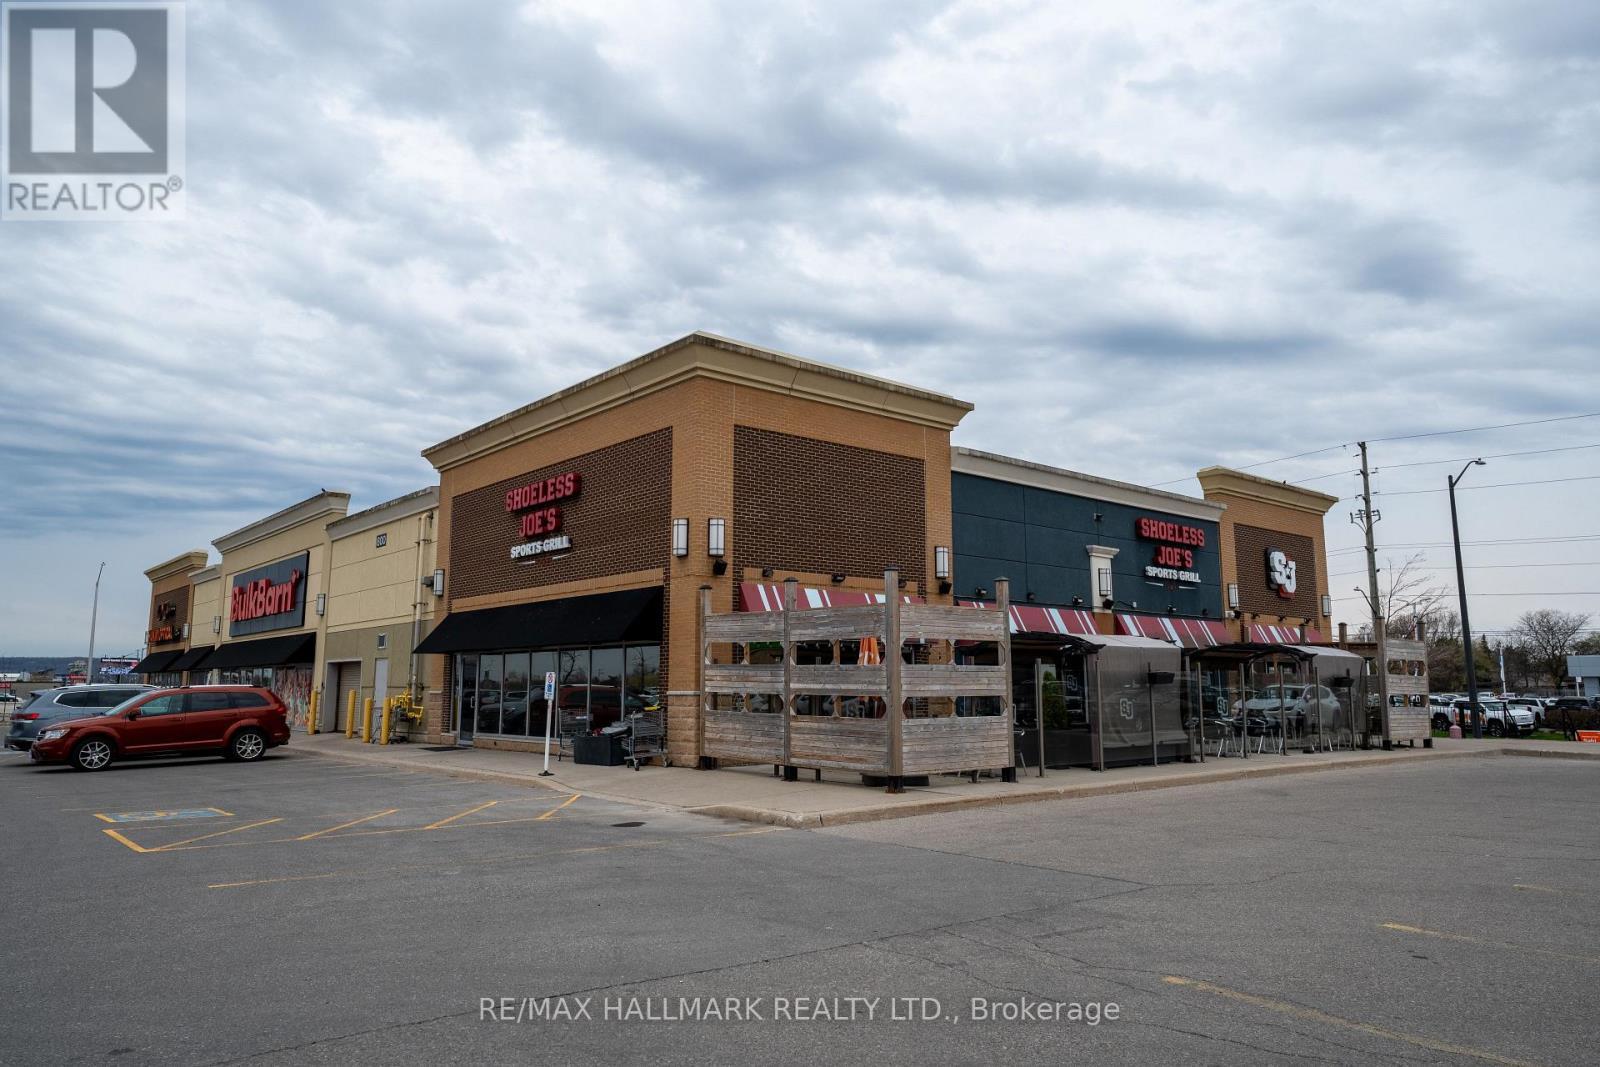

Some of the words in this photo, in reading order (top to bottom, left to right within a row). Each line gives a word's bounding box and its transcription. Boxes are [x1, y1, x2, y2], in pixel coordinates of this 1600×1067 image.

[506, 472, 580, 512] SHOELESS
[518, 507, 561, 538] JOE'S
[1138, 517, 1206, 548] SHOELESS
[510, 541, 542, 558] SPORTS
[542, 535, 571, 552] GRILL
[1156, 545, 1194, 568] JOE'S
[1145, 565, 1178, 580] SPORTS
[1178, 570, 1202, 583] GRILL
